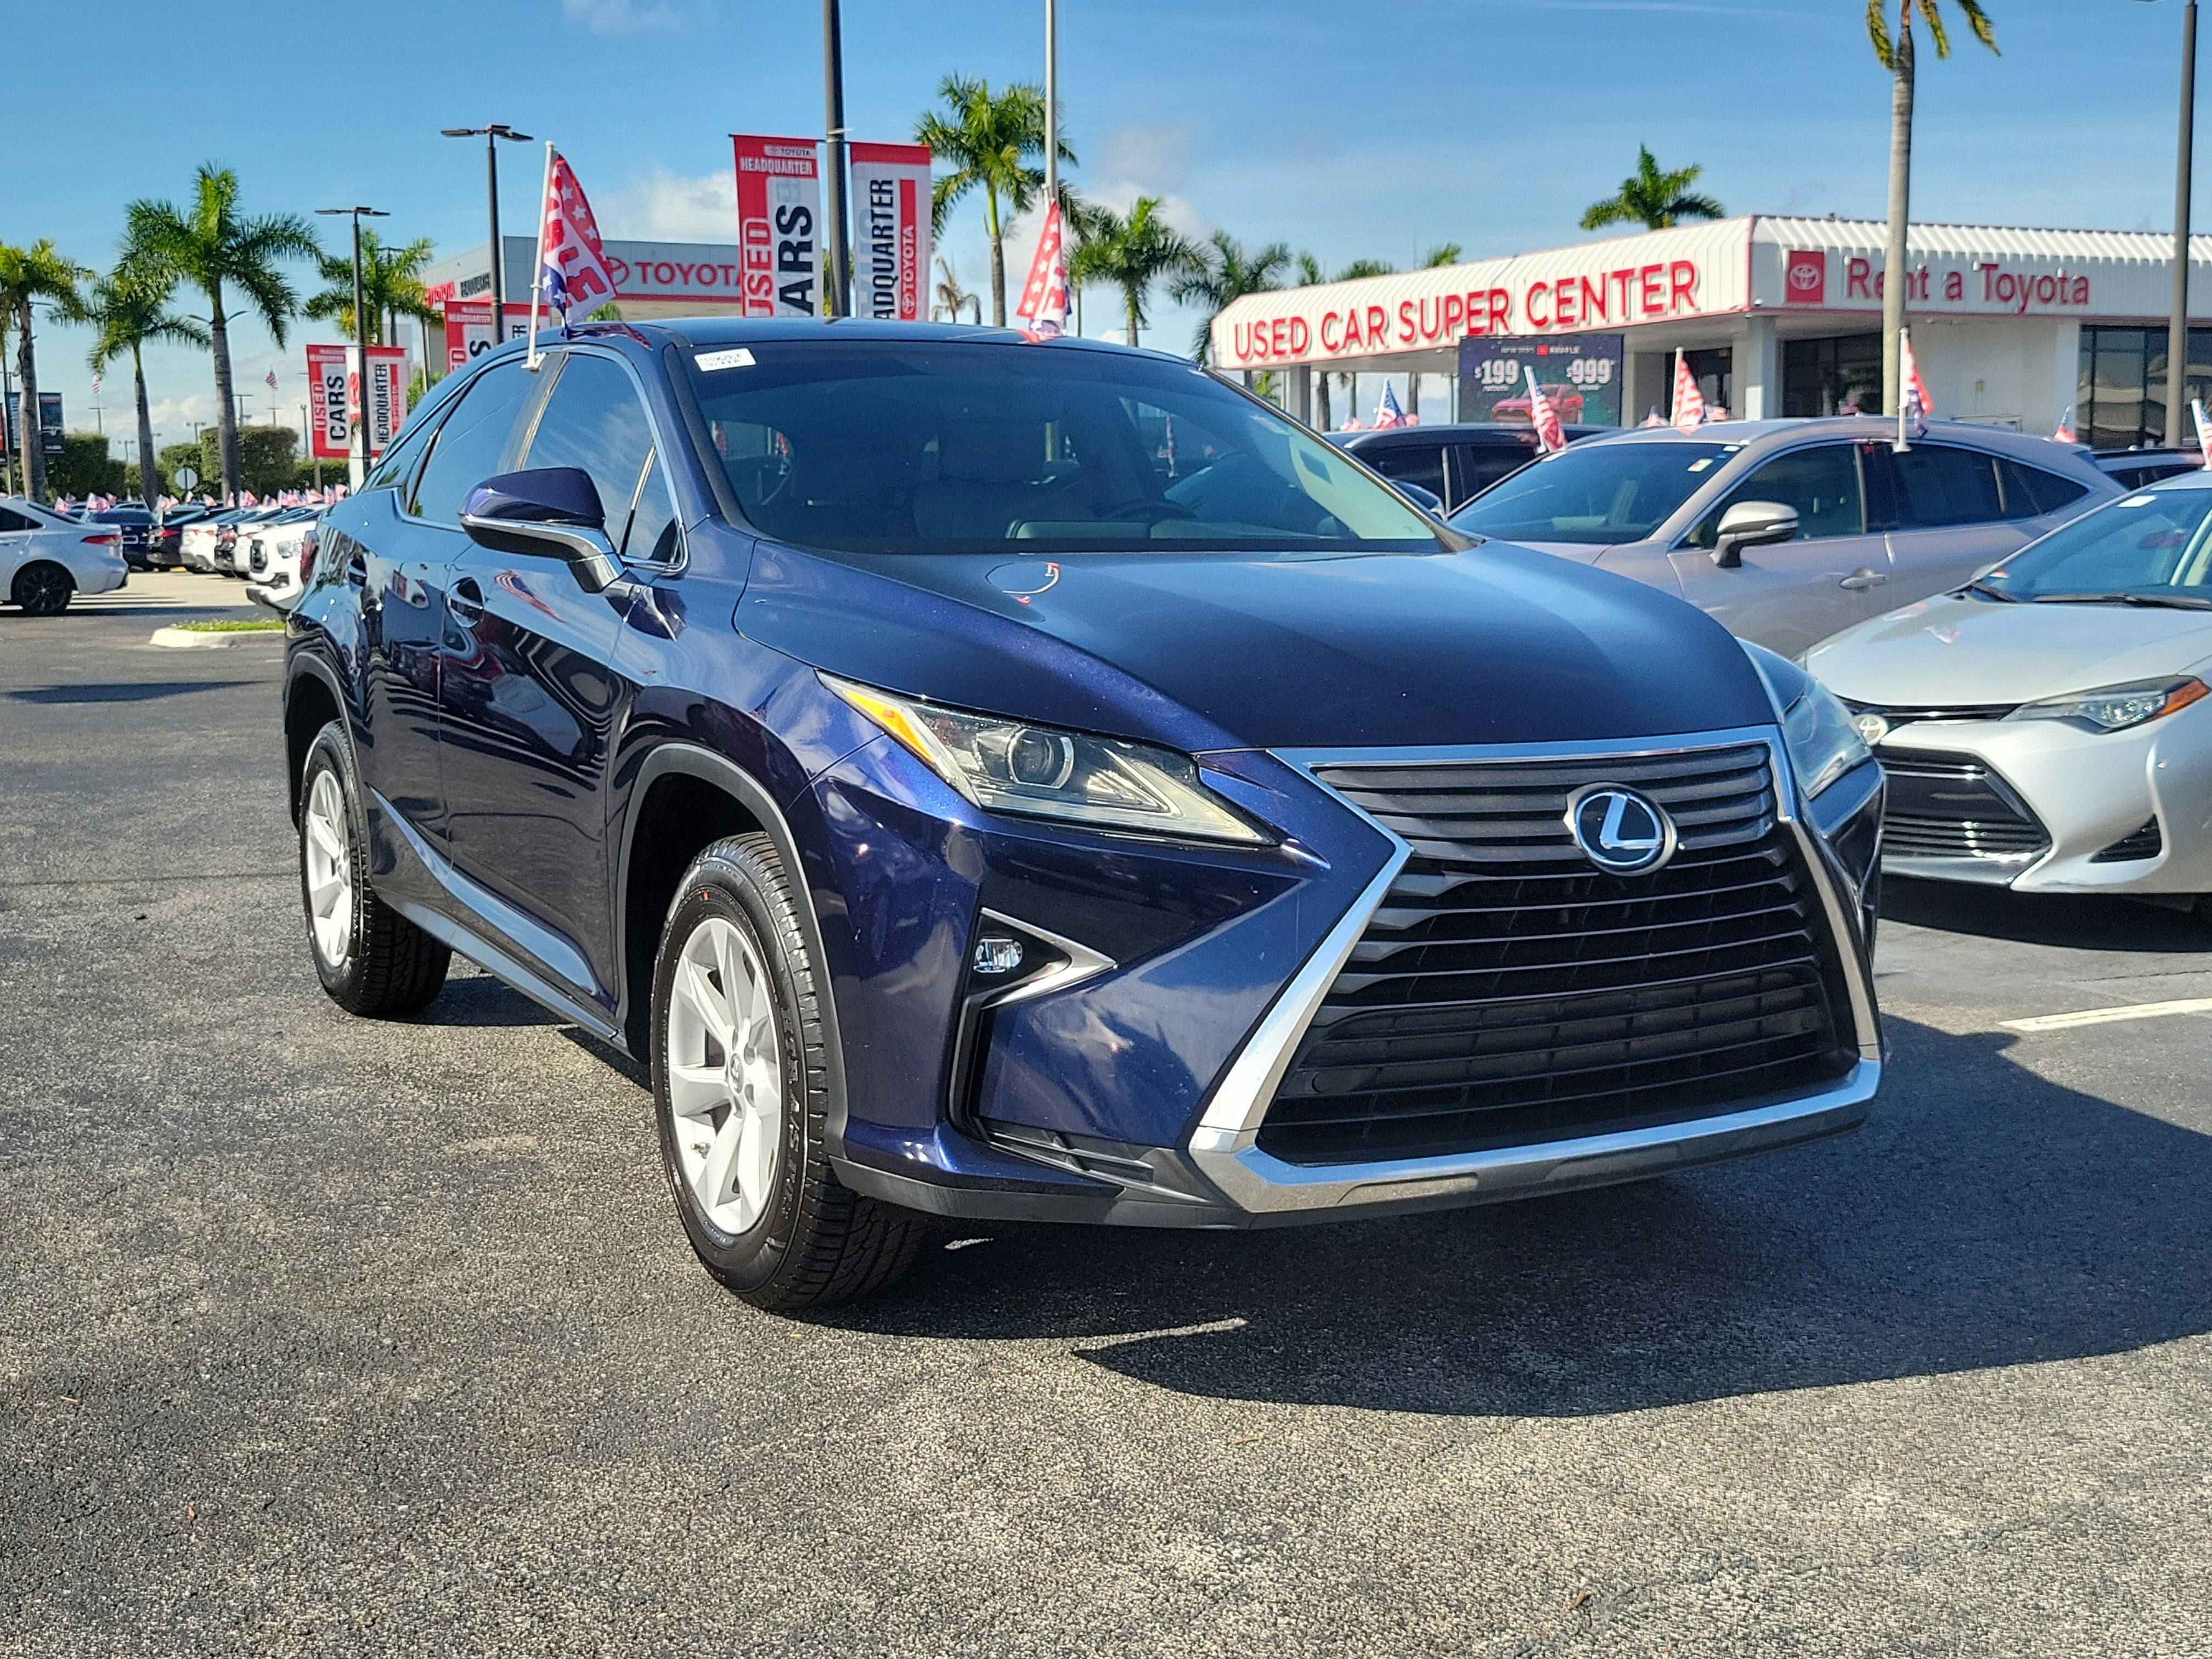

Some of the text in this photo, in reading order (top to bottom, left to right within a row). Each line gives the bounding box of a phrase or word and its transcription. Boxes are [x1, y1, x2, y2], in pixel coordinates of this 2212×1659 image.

[740, 156, 813, 175] HEADQUARTER
[634, 262, 741, 286] TOYOT
[775, 205, 814, 317] ARS
[870, 179, 899, 319] ADQUARTER
[901, 225, 915, 293] TOYOTA
[1234, 259, 1696, 361] USED CAR SUPER CENTER
[1946, 271, 1963, 301] a
[1980, 263, 2089, 315] Toyota
[313, 383, 328, 430] USED
[327, 375, 347, 441] CARS
[375, 363, 391, 444] HEADQUARTER
